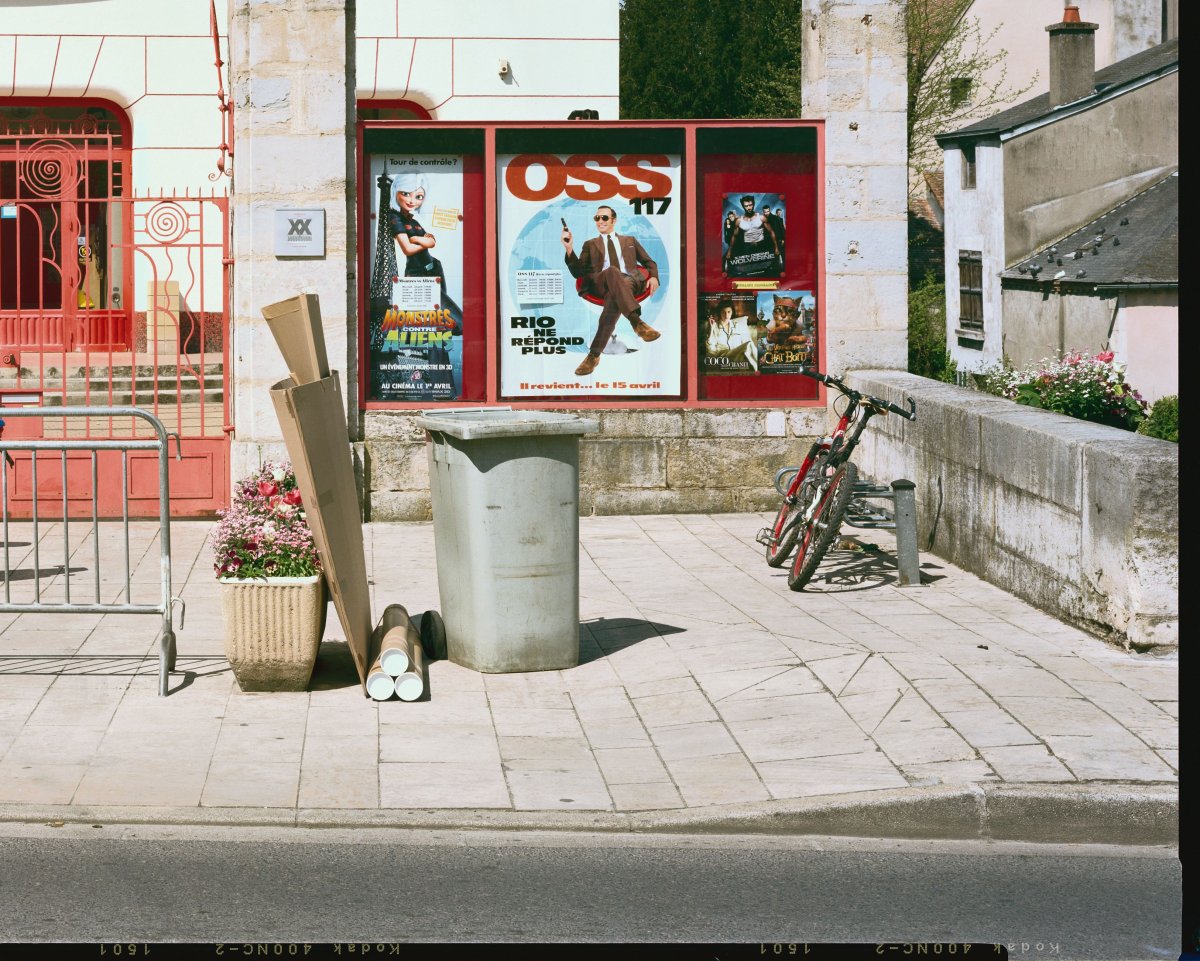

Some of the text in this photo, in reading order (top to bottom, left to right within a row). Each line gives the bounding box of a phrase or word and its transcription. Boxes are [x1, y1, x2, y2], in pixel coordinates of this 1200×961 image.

[409, 158, 419, 166] de
[505, 153, 673, 202] OSS
[629, 197, 672, 215] 117
[730, 253, 776, 265] WOLVERINE
[381, 309, 457, 332] MONSTRES
[511, 317, 556, 329] RIO
[534, 329, 557, 337] NE
[381, 330, 454, 352] ALIENS
[511, 335, 585, 347] RÉPOND
[522, 347, 567, 355] PLUS
[704, 357, 730, 366] COCO
[530, 382, 593, 390] revient...
[100, 943, 401, 955] Kodak 400NC-2 1501
[760, 942, 1061, 955] Kodak 400NC-2 1501
